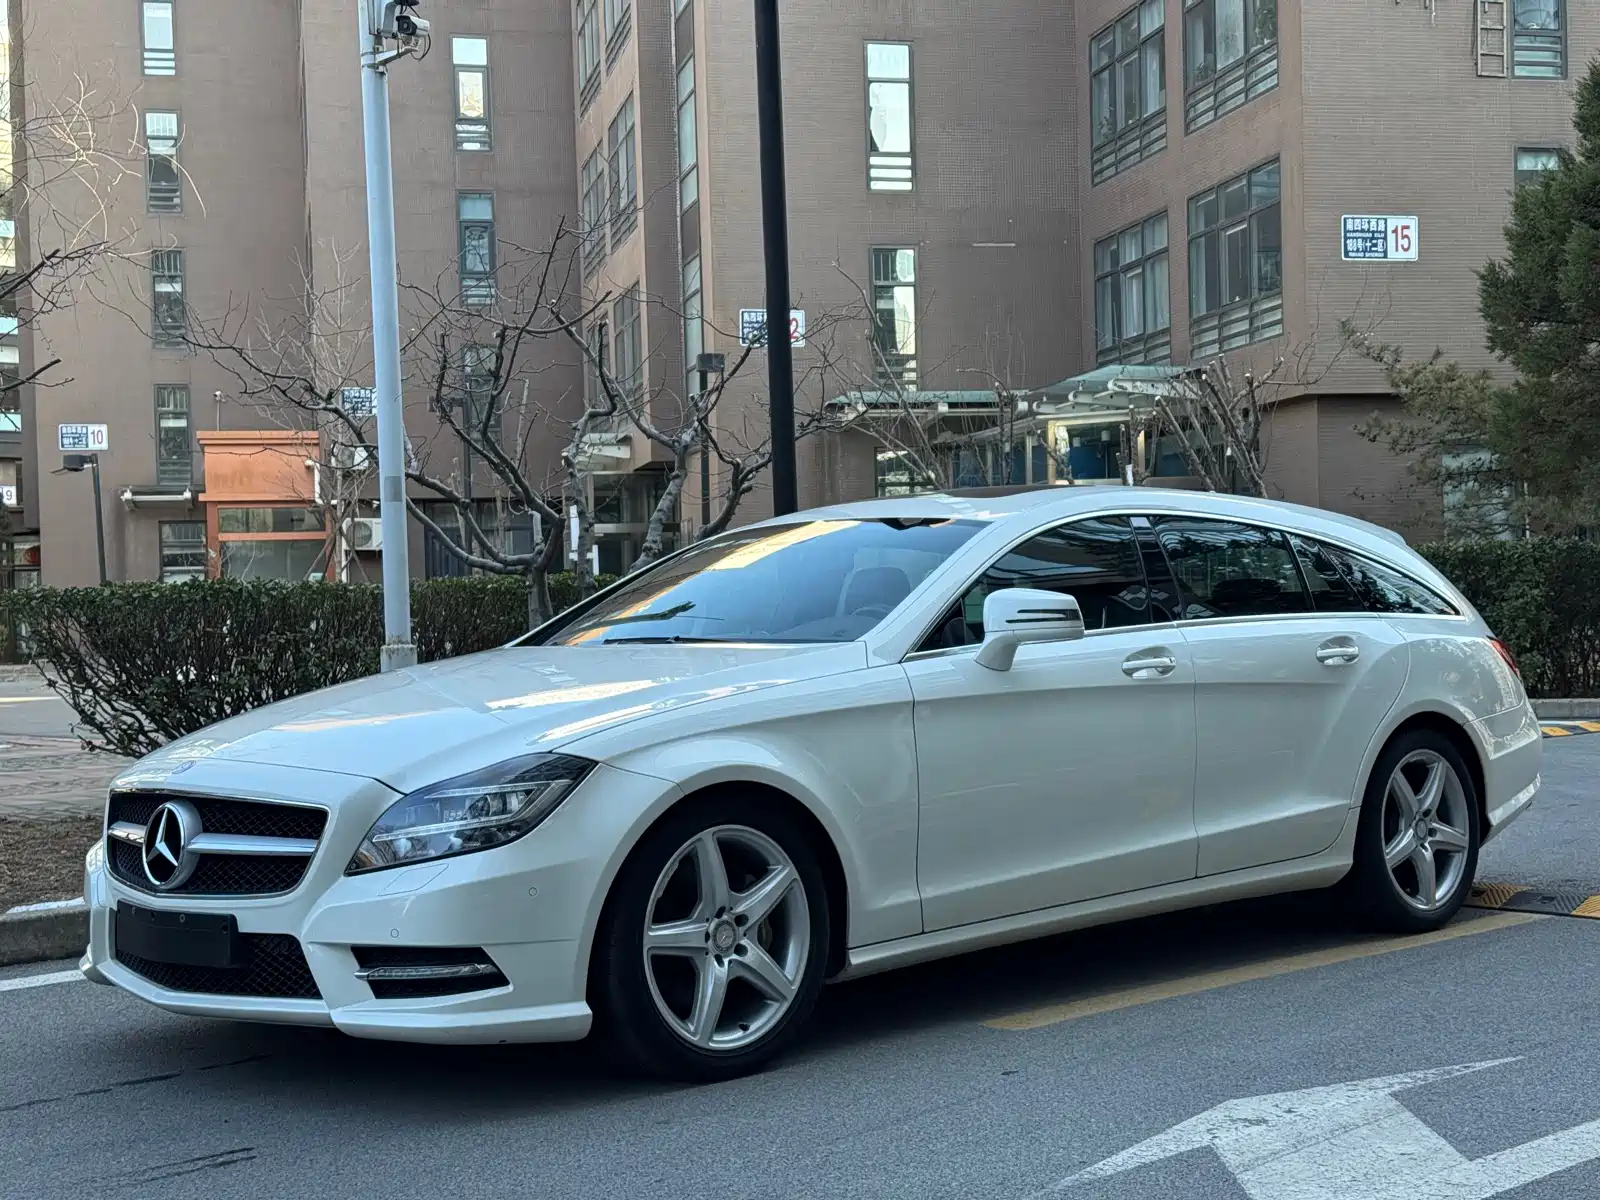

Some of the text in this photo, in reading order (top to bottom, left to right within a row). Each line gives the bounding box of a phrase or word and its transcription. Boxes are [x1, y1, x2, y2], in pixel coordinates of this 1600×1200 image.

[1346, 218, 1386, 231] 南四环西路
[1391, 225, 1411, 252] 15
[91, 430, 103, 445] 10
